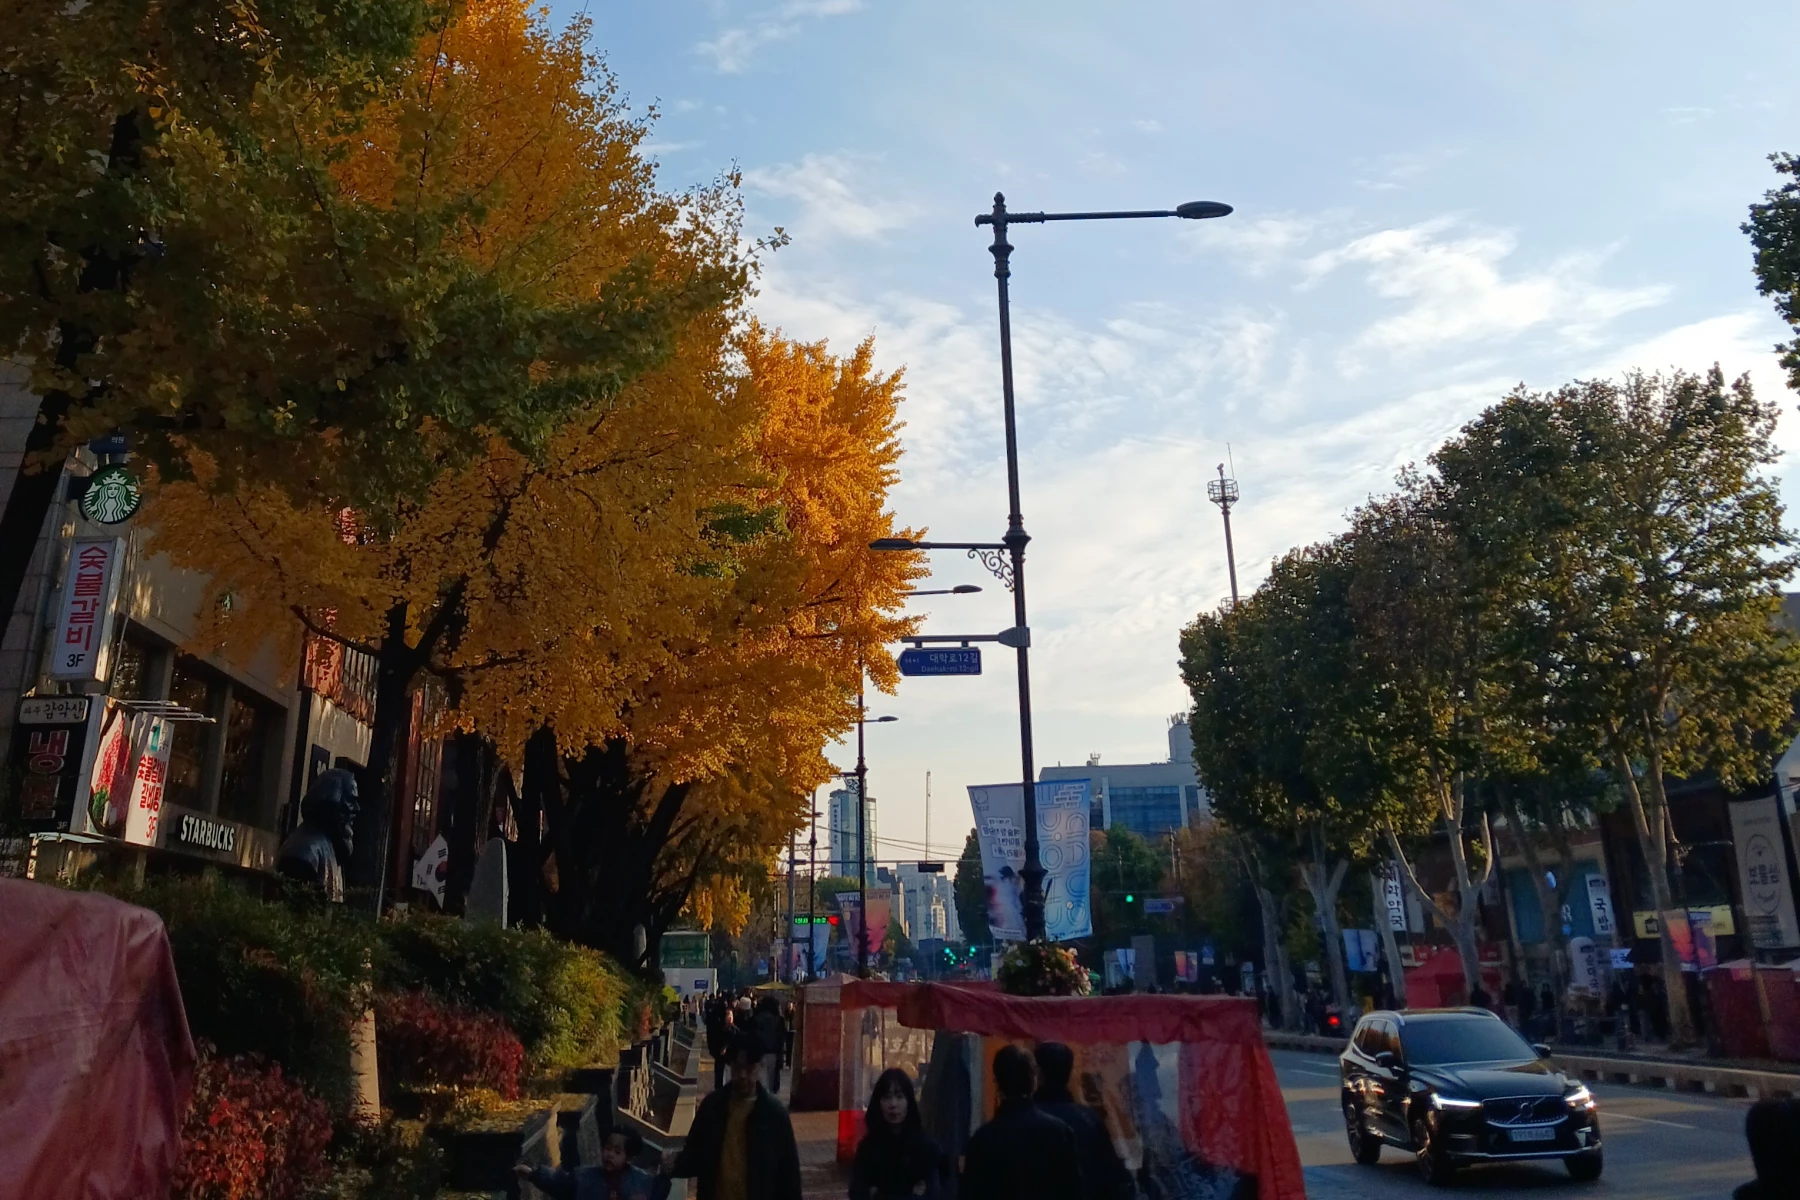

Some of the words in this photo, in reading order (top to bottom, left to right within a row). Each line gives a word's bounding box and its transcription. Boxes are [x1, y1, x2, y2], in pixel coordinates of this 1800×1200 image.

[65, 545, 108, 651] 숯불갈비
[66, 653, 85, 669] 3F
[929, 652, 978, 664] 대학로12길
[921, 665, 958, 673] Daehak-ro
[959, 665, 979, 674] 12-gil
[43, 701, 84, 719] 감악산
[137, 754, 167, 785] 숯불갈비
[139, 783, 162, 812] 갈비탕
[56, 820, 68, 830] 3F
[145, 816, 158, 839] 3F
[180, 814, 235, 853] STARBUCKS
